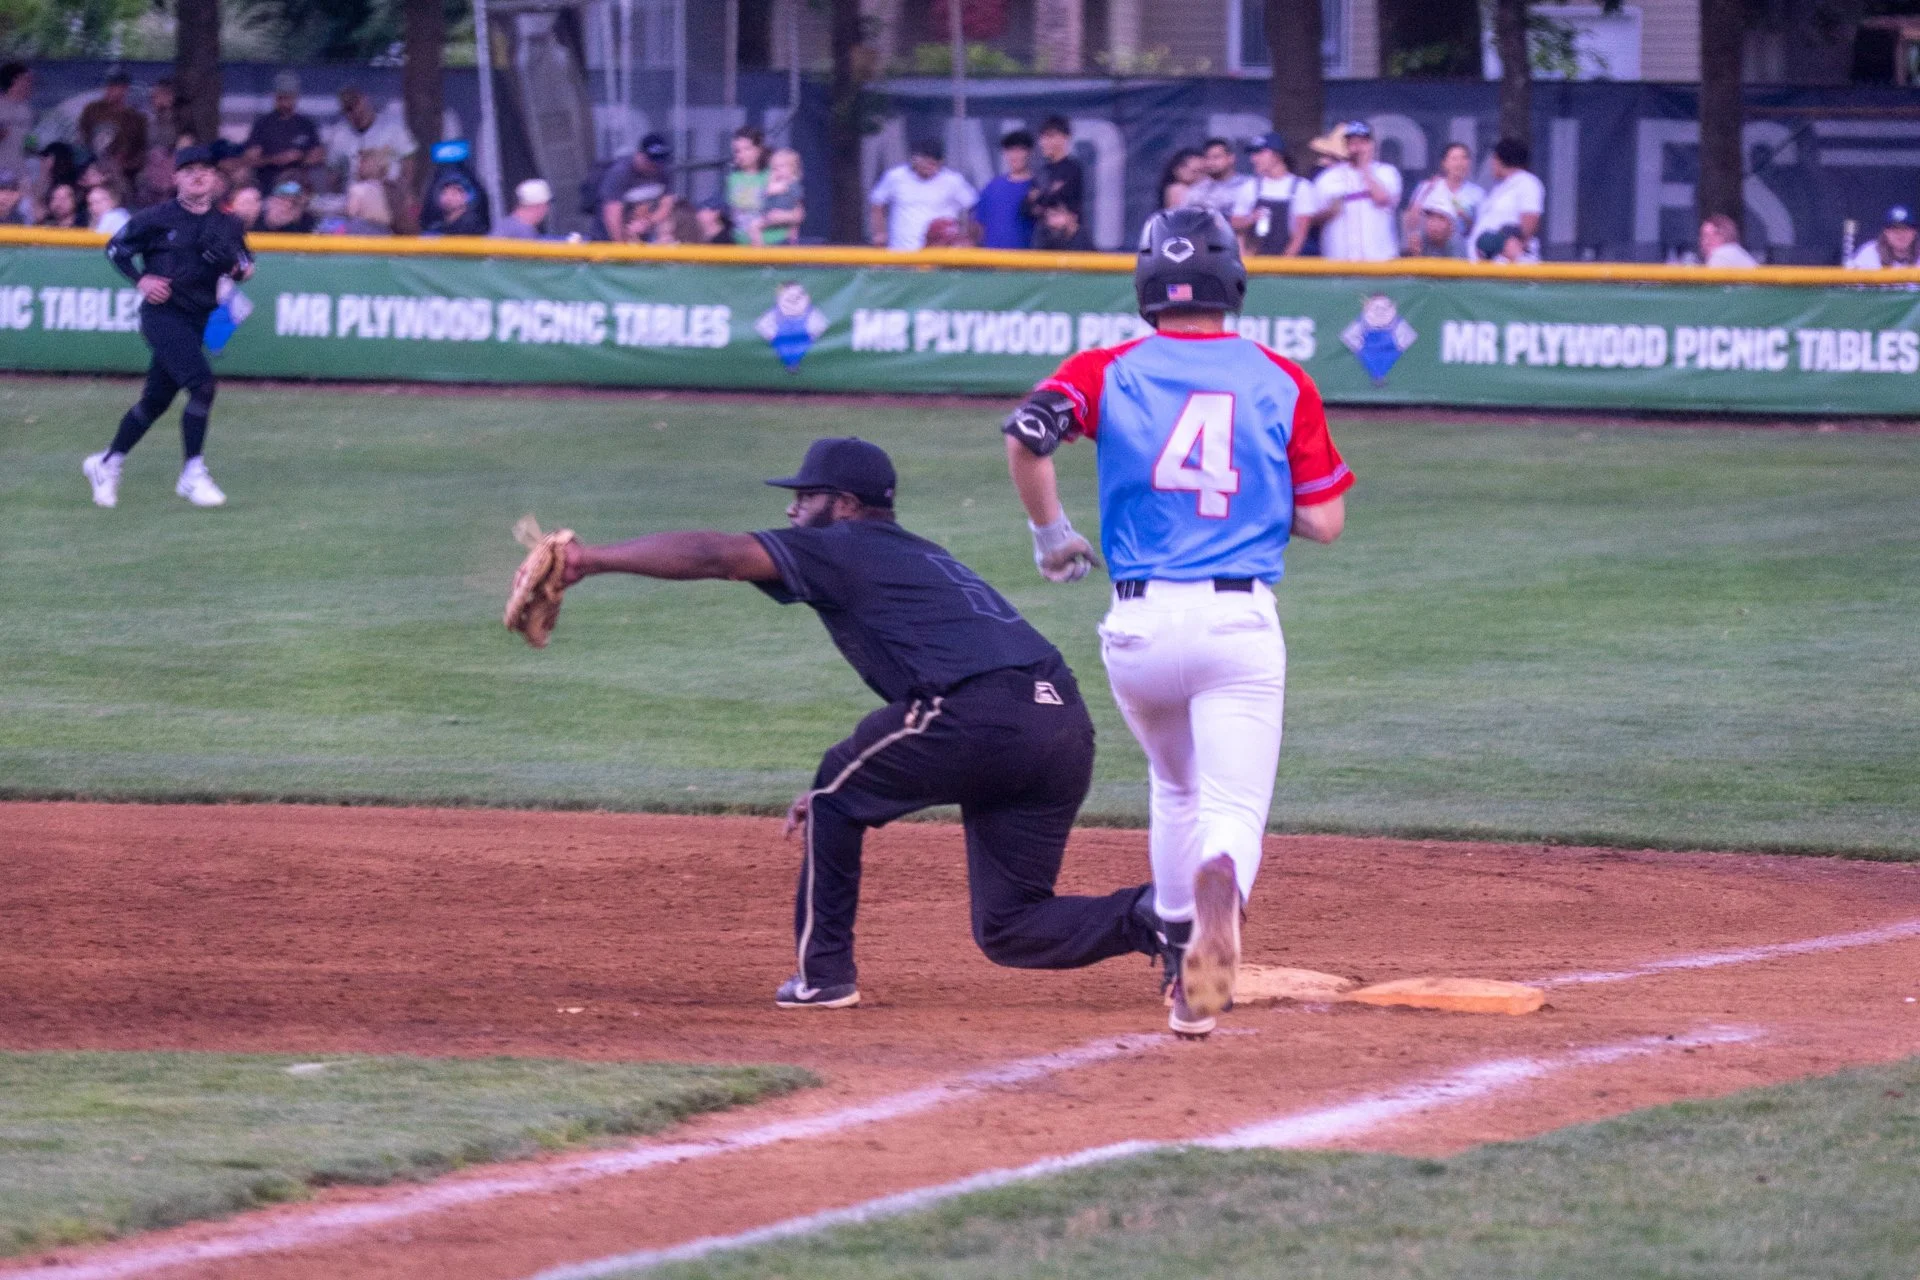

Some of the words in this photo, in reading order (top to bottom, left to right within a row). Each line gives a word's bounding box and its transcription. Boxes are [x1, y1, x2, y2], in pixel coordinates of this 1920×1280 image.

[40, 287, 143, 331] TABLE
[276, 293, 331, 336] MR
[336, 295, 493, 341] PLYWOOD
[496, 298, 608, 345] PICNIC
[612, 302, 732, 348] TABLES
[850, 307, 910, 353] MR
[913, 309, 1072, 356] PLYWOOD
[1077, 312, 1156, 353] PIC
[1441, 320, 1498, 364] MR
[1504, 321, 1668, 368] PLYWOOD
[1674, 326, 1789, 371] PICNIC
[1796, 328, 1919, 373] TABLES
[1153, 391, 1240, 520] 4
